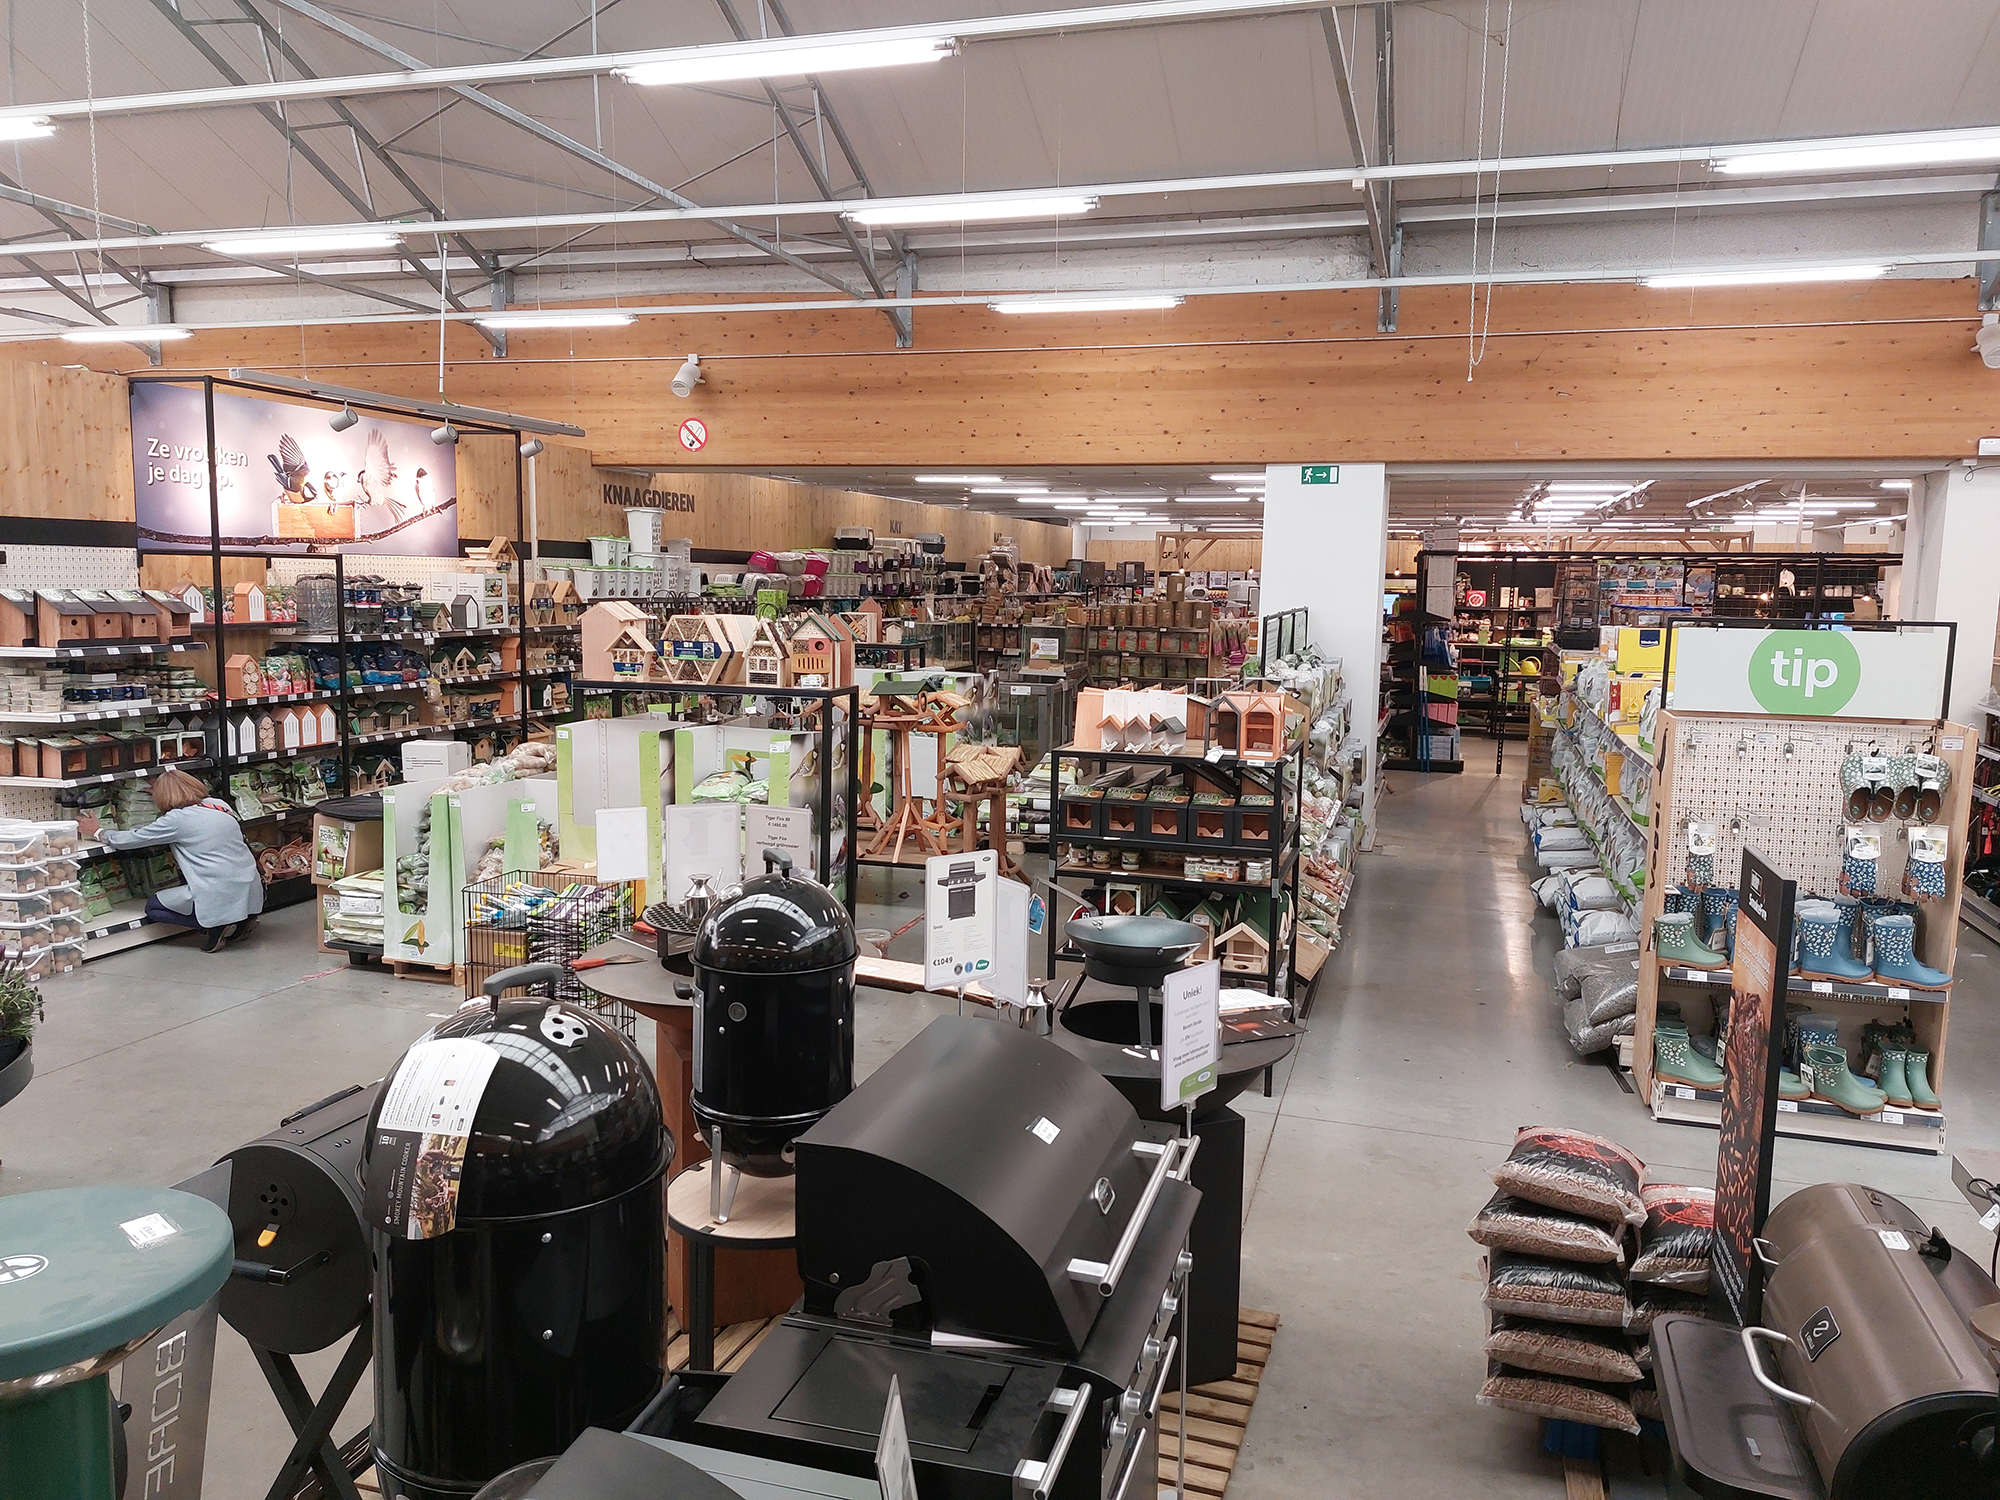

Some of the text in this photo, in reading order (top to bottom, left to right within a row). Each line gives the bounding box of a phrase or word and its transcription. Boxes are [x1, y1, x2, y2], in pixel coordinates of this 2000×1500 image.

[147, 437, 171, 459] Ze
[147, 461, 165, 486] je
[169, 464, 203, 489] dag
[603, 483, 695, 513] KNAAGDIEREN
[889, 519, 903, 534] KAT
[1770, 648, 1838, 698] tip
[932, 956, 953, 966] €1049
[1182, 985, 1203, 1000] Uniek!
[381, 1136, 390, 1145] 10
[394, 1142, 412, 1225] SMOKEY MOUNTAIN COOKER
